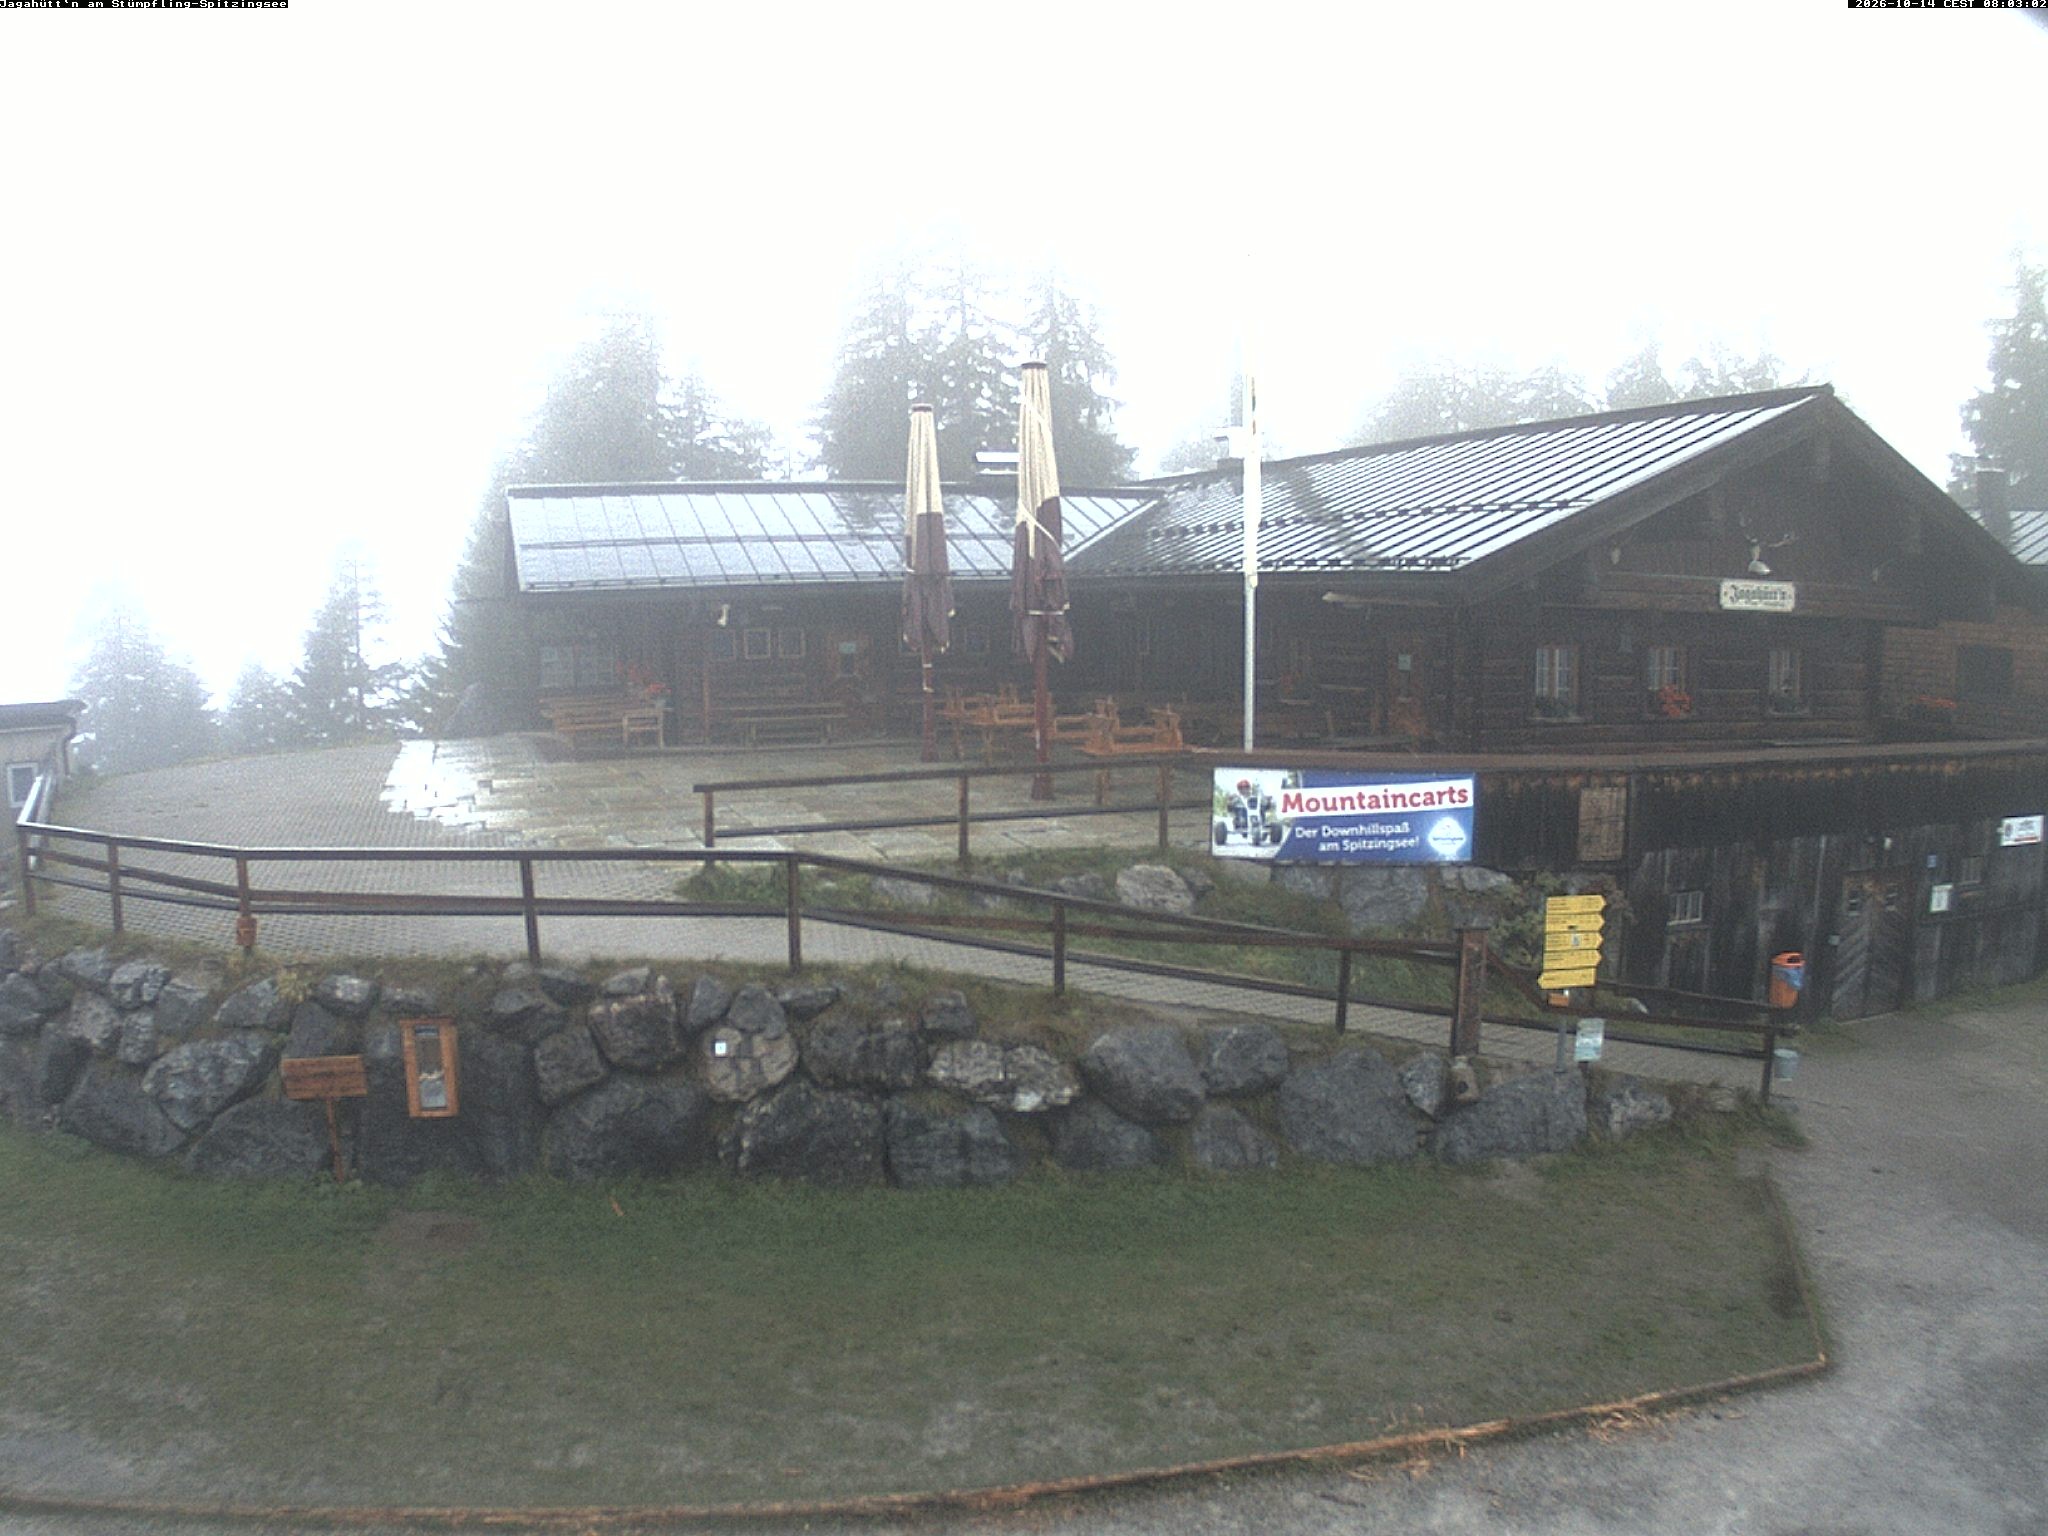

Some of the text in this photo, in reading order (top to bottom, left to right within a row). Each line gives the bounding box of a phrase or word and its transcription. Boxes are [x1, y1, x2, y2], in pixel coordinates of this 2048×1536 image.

[1281, 785, 1469, 814] Mountaincarts
[1295, 822, 1410, 839] Der Downhillspaß
[1318, 841, 1341, 852] am
